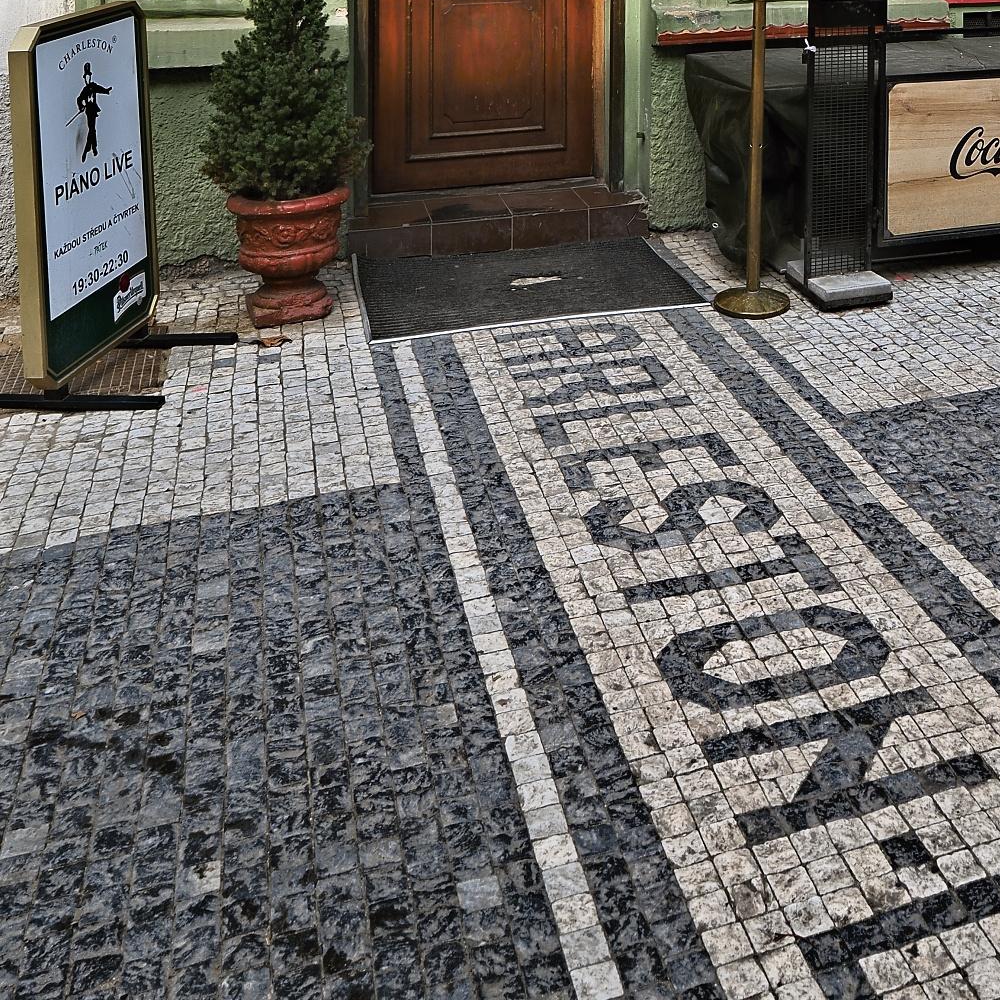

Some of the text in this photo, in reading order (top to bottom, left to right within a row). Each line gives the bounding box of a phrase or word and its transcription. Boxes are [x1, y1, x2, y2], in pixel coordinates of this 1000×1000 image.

[103, 150, 134, 180] LIVE
[107, 219, 113, 229] A
[73, 250, 129, 296] 19:30-22:30
